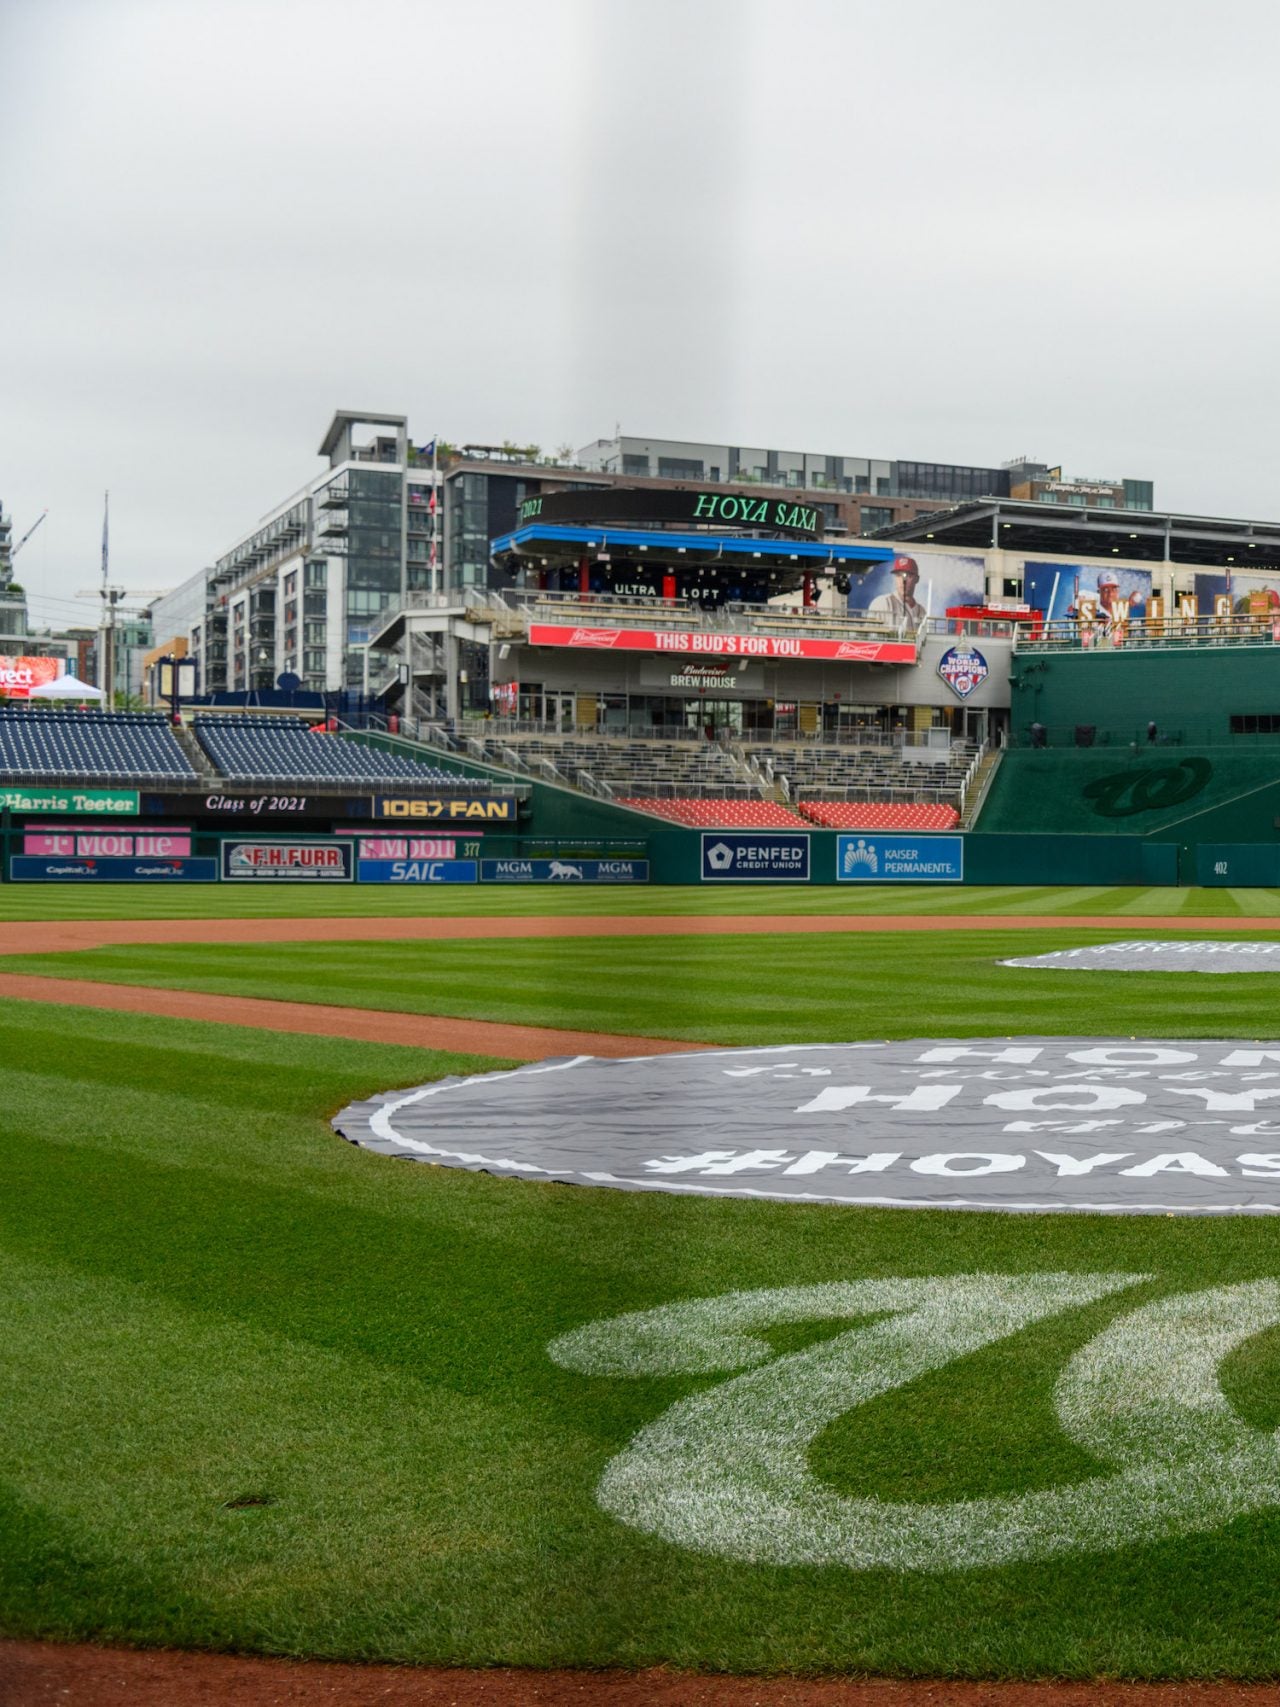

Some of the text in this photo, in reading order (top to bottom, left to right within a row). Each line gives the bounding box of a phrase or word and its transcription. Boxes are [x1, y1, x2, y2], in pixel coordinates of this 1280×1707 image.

[692, 495, 818, 532] HOYA SAXA
[615, 583, 719, 599] ULTRA LOFT
[654, 632, 805, 656] THIS BUD'S FOR YOU.
[670, 675, 737, 689] BREW HOUSE
[5, 793, 134, 811] Harris Teeter
[206, 795, 307, 814] Class of 2021
[450, 801, 508, 818] FAN
[464, 842, 480, 857] 377
[736, 847, 803, 861] PENFED
[885, 850, 918, 860] KAISER
[390, 862, 444, 882] SAIC
[496, 862, 532, 873] MGM
[598, 863, 633, 874] MGM
[736, 861, 802, 869] CREDIT UNION
[885, 863, 953, 873] PERMANENTE
[1214, 861, 1228, 875] 402
